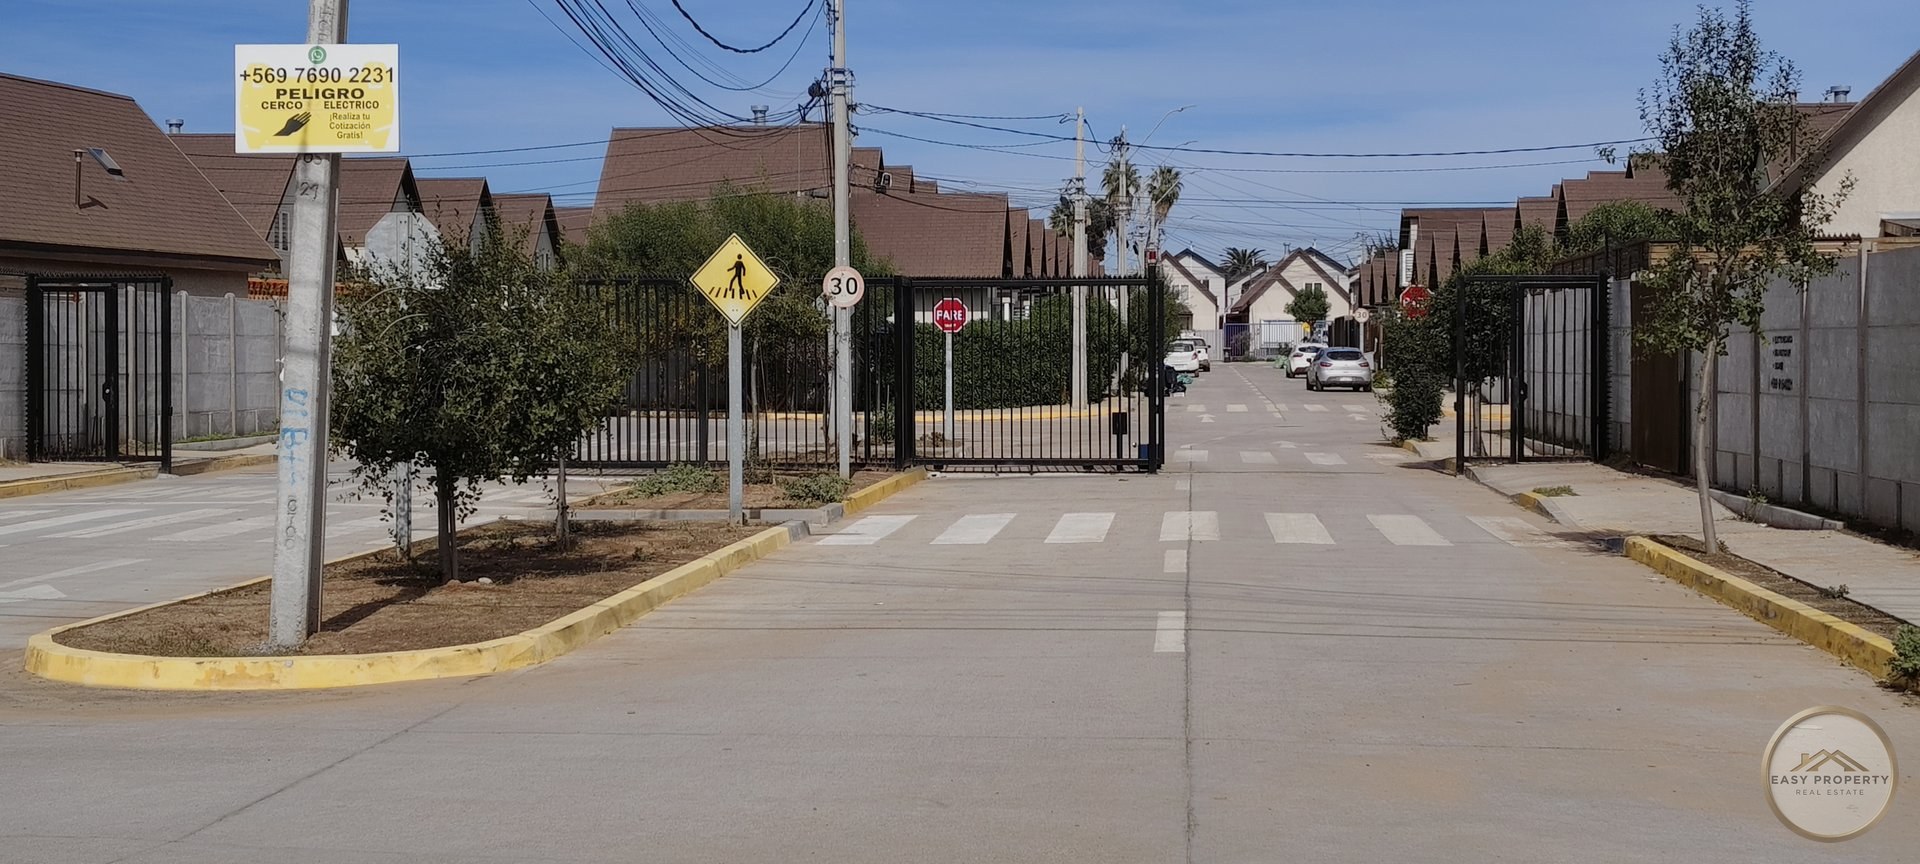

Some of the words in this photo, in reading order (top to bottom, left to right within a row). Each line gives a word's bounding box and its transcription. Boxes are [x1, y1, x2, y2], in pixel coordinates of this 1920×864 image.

[240, 67, 287, 84] +569
[295, 67, 341, 83] 7690
[349, 66, 393, 83] 2231
[276, 88, 364, 99] PELIGRO
[261, 101, 303, 110] CERCO
[324, 100, 379, 109] ELECTRICO
[329, 112, 360, 121] ¡Realiza
[329, 121, 371, 130] Cotización
[336, 131, 363, 139] Gratis!
[830, 277, 858, 295] 30
[936, 310, 963, 320] PARE
[1357, 311, 1367, 319] 30
